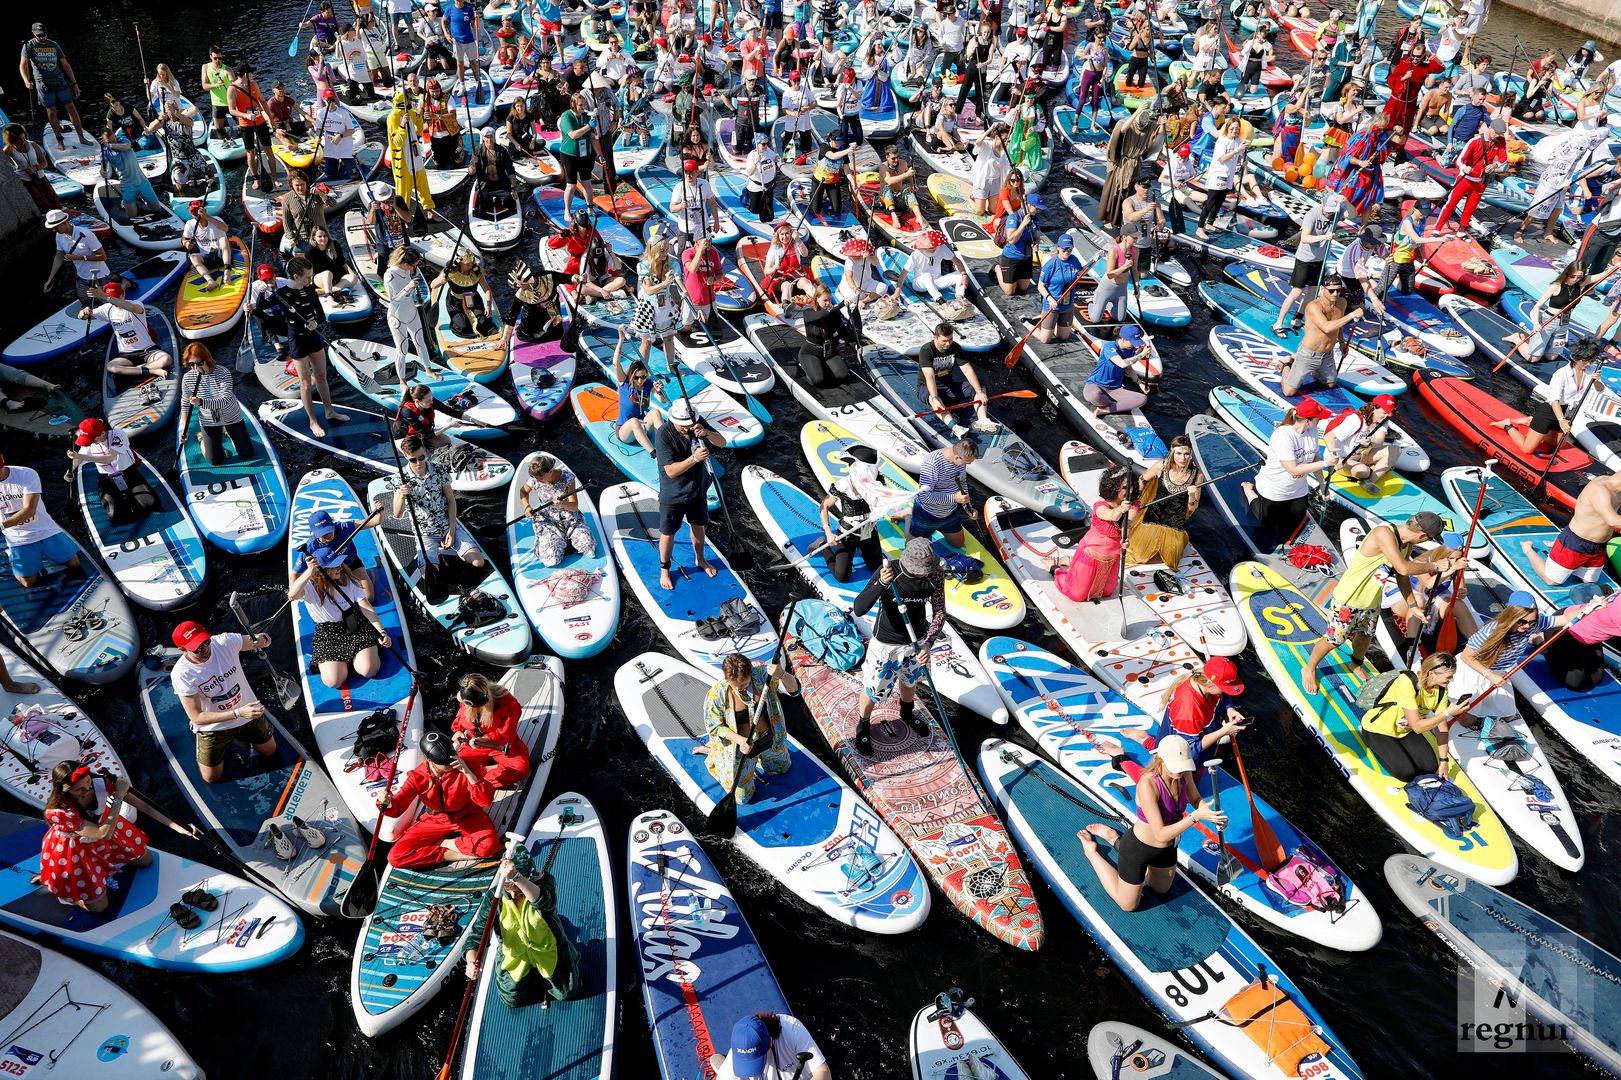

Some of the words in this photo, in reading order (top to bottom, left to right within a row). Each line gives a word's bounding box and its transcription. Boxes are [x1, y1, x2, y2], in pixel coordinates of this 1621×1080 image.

[283, 769, 313, 821] GLADIATOR
[895, 781, 971, 813] Bombitto
[955, 842, 981, 857] 0877
[1436, 932, 1481, 971] GLADIATOR
[0, 1059, 28, 1077] 5125
